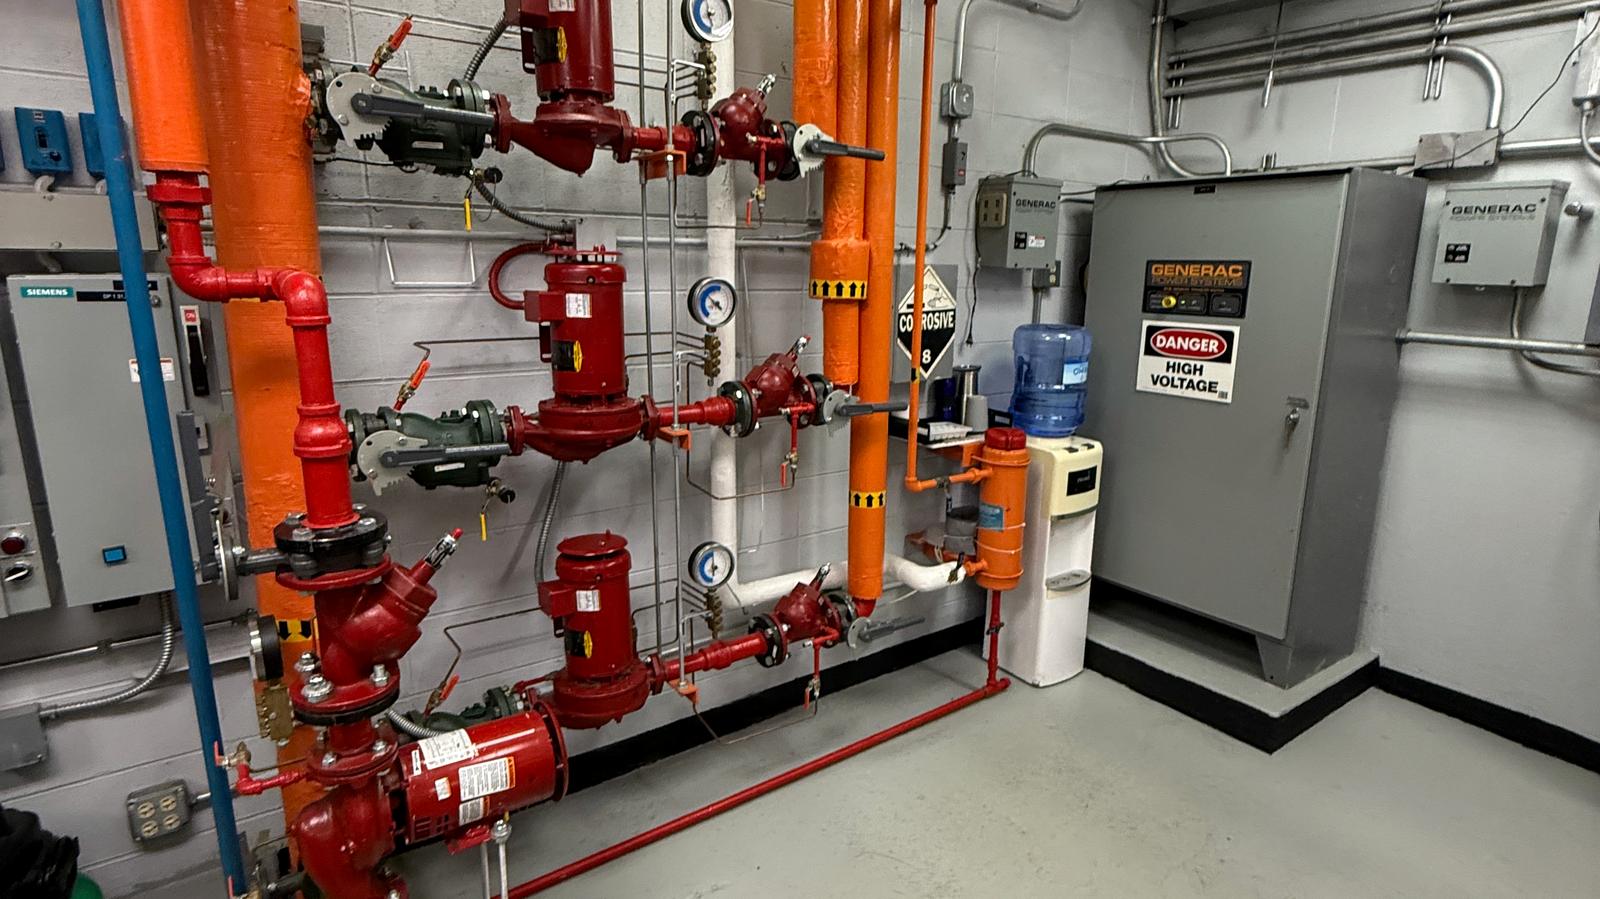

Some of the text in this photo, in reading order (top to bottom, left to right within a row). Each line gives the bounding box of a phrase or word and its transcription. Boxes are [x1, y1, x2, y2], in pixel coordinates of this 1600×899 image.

[1015, 199, 1057, 209] GENERAC
[1452, 204, 1536, 215] GENERAC
[1151, 264, 1242, 276] GENERAC
[1151, 277, 1242, 287] POWER SYSTEMS
[26, 288, 69, 296] SIEMENS
[899, 310, 954, 333] COROSIVE
[1156, 335, 1219, 353] DANGER
[922, 348, 931, 364] 8
[1166, 361, 1204, 376] HIGH
[1151, 374, 1218, 393] VOLTAGE
